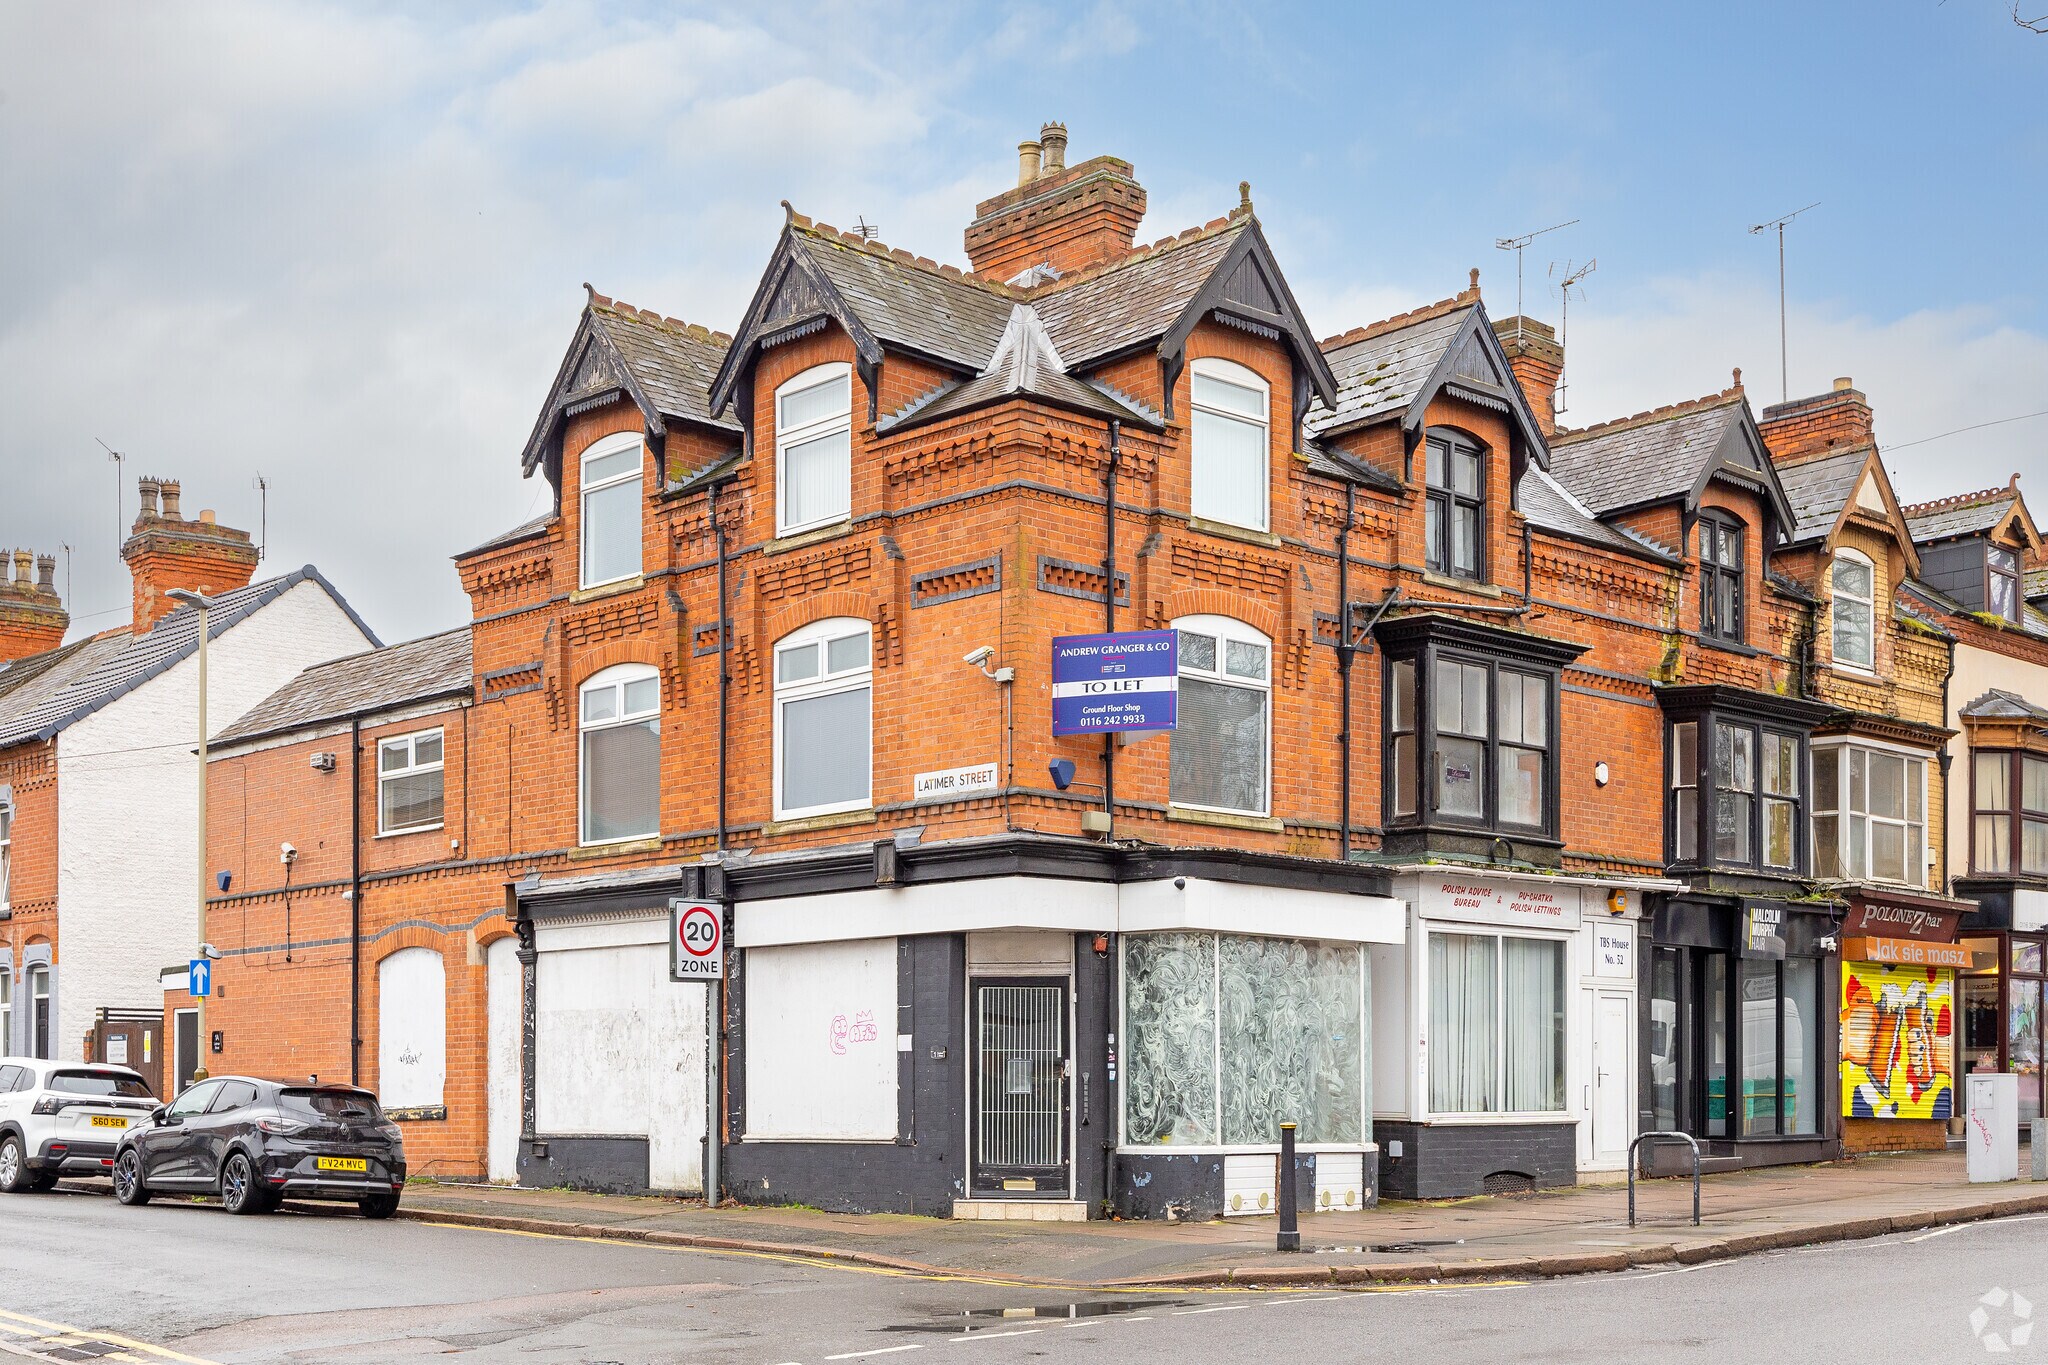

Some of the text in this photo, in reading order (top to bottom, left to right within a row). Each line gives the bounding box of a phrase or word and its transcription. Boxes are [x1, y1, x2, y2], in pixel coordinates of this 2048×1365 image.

[1060, 646, 1099, 657] ANDREW
[1101, 644, 1144, 654] GRANGER
[1155, 642, 1170, 651] CO
[1082, 680, 1143, 693] TO LET
[1082, 703, 1140, 714] Ground Floor Shop
[1081, 714, 1145, 727] 0116 242 9933
[918, 770, 993, 792] LATIMER STREET
[1442, 884, 1492, 897] POLISH ADVICE
[1454, 898, 1481, 908] BUREAU
[1497, 896, 1502, 904] &
[1510, 903, 1562, 916] POLISH LETTINGS
[1753, 908, 1780, 923] MALCOLM
[1859, 904, 1942, 935] POLONEZ bar
[686, 922, 714, 942] 20
[1752, 922, 1776, 937] MURPHY
[1600, 937, 1629, 950] TBS House
[1752, 937, 1765, 950] HAIR
[1875, 938, 1899, 960] Jak
[1927, 949, 1966, 964] masz
[1605, 954, 1624, 964] No. 52
[681, 960, 718, 972] ZONE
[93, 1118, 126, 1127] S60 SEW
[322, 1159, 363, 1169] FV24 MVC
